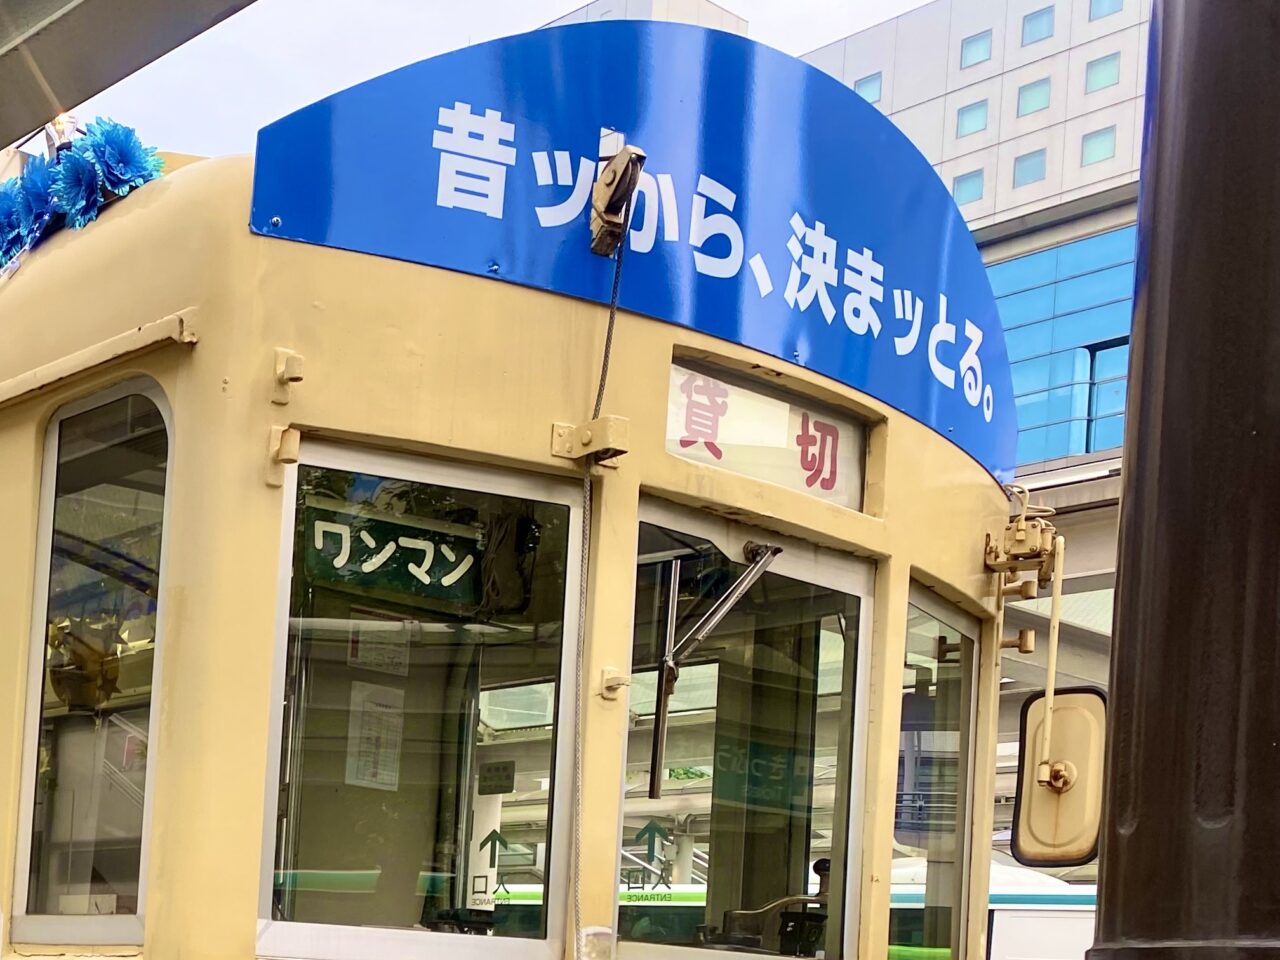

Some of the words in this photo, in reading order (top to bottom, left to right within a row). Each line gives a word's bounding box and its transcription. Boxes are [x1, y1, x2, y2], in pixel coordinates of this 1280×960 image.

[432, 101, 993, 423] 昔ッから、決まッとる。
[680, 374, 839, 491] 貸切
[314, 520, 474, 587] ワンマン
